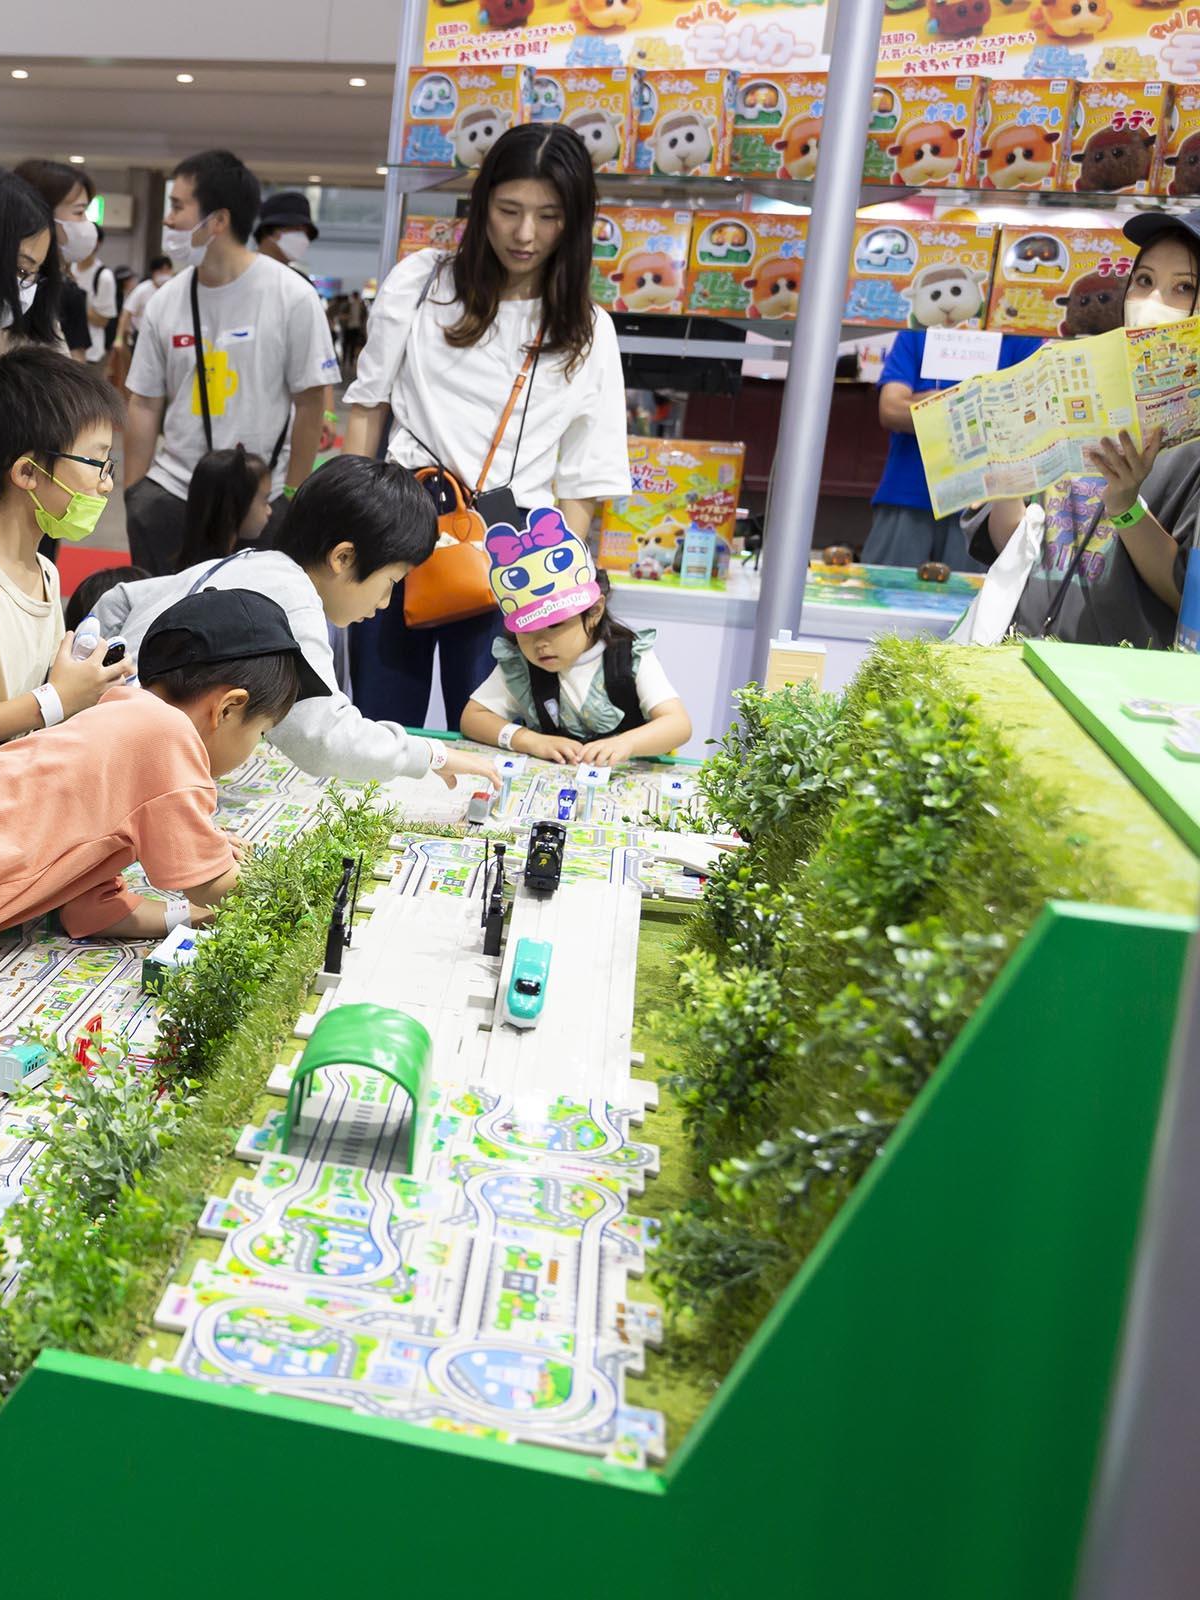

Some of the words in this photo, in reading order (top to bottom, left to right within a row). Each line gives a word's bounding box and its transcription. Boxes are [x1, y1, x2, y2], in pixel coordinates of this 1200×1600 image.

[685, 24, 815, 67] モルカー
[1111, 110, 1155, 132] テディ
[1097, 256, 1132, 278] テデ
[631, 463, 667, 476] ルカー
[632, 476, 677, 494] Xセット
